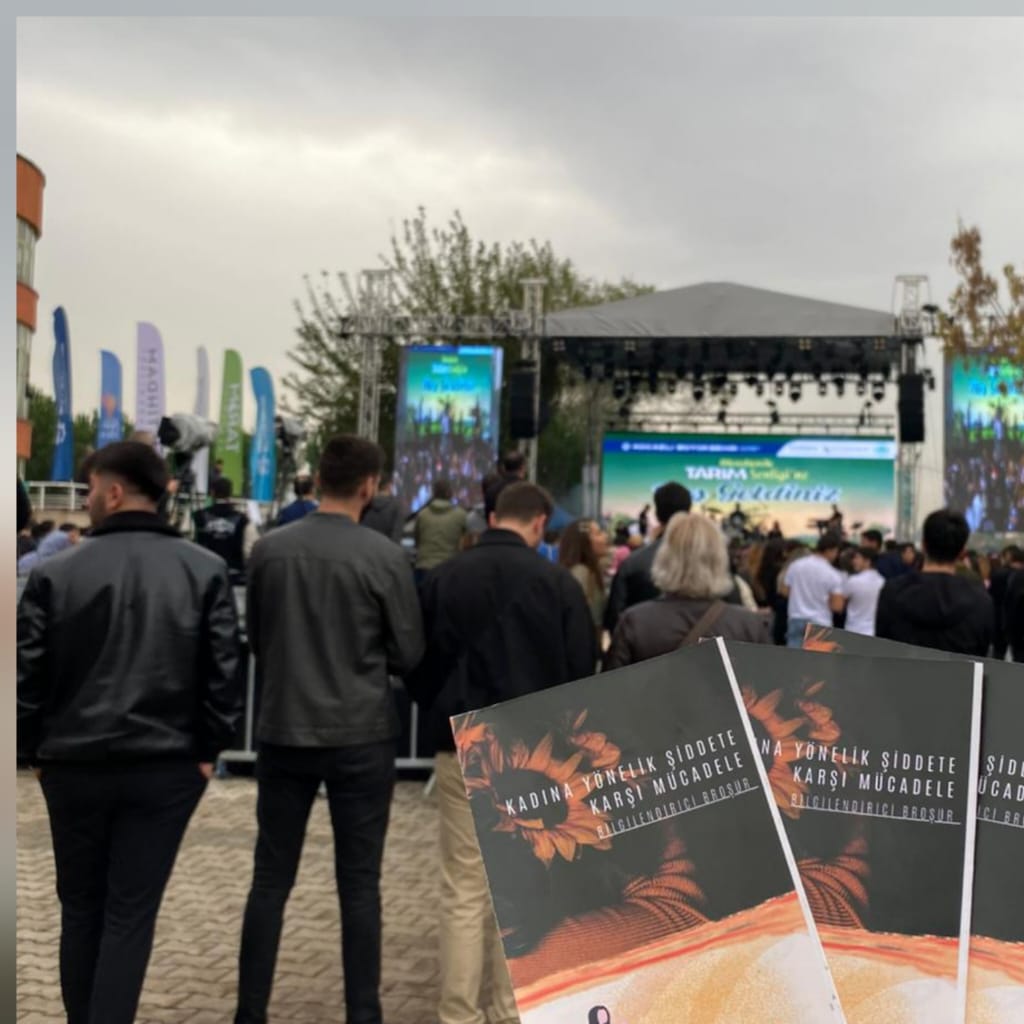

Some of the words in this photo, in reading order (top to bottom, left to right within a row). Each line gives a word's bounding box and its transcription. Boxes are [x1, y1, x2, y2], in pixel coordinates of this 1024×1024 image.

[505, 782, 575, 816] KADINA
[582, 755, 658, 793] YÖNELİK
[665, 729, 737, 773] ŞİDDETE
[793, 766, 847, 792] KARŞI
[858, 771, 955, 799] MÜCADELE
[794, 742, 870, 766] YÖNELİK
[881, 750, 957, 775] ŞİDDETE
[589, 784, 645, 815] KARŞI
[652, 751, 745, 796] MÜCADELE
